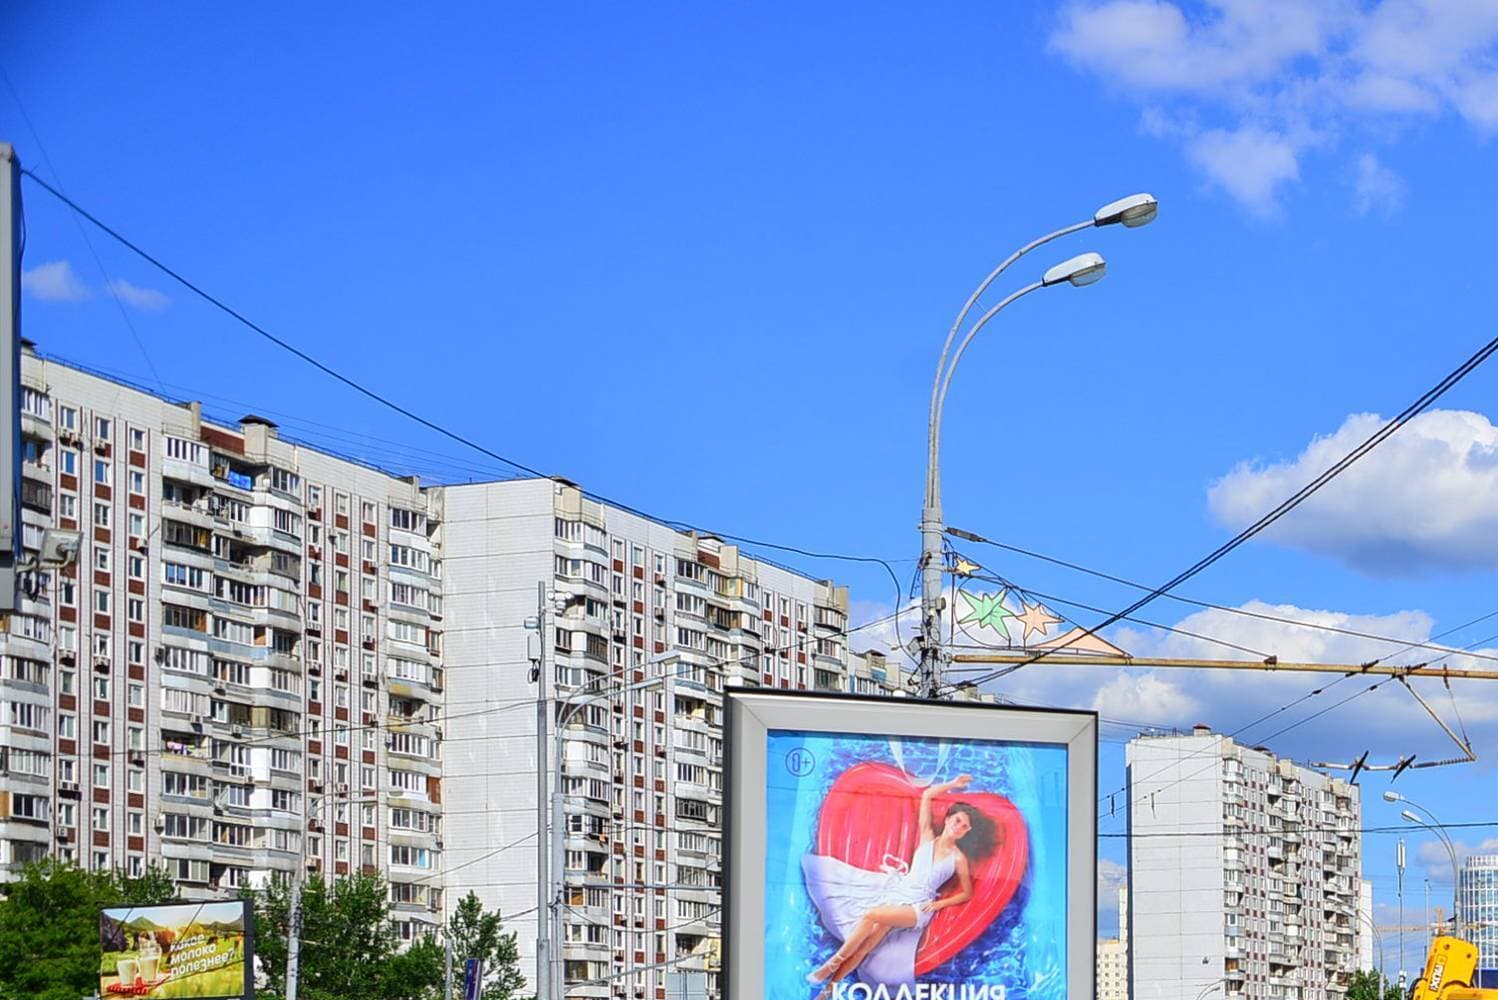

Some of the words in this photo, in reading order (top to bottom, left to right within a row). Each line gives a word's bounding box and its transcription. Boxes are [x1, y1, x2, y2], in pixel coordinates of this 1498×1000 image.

[170, 933, 205, 952] какое
[170, 943, 217, 964] молоко
[170, 947, 235, 977] полезнее?
